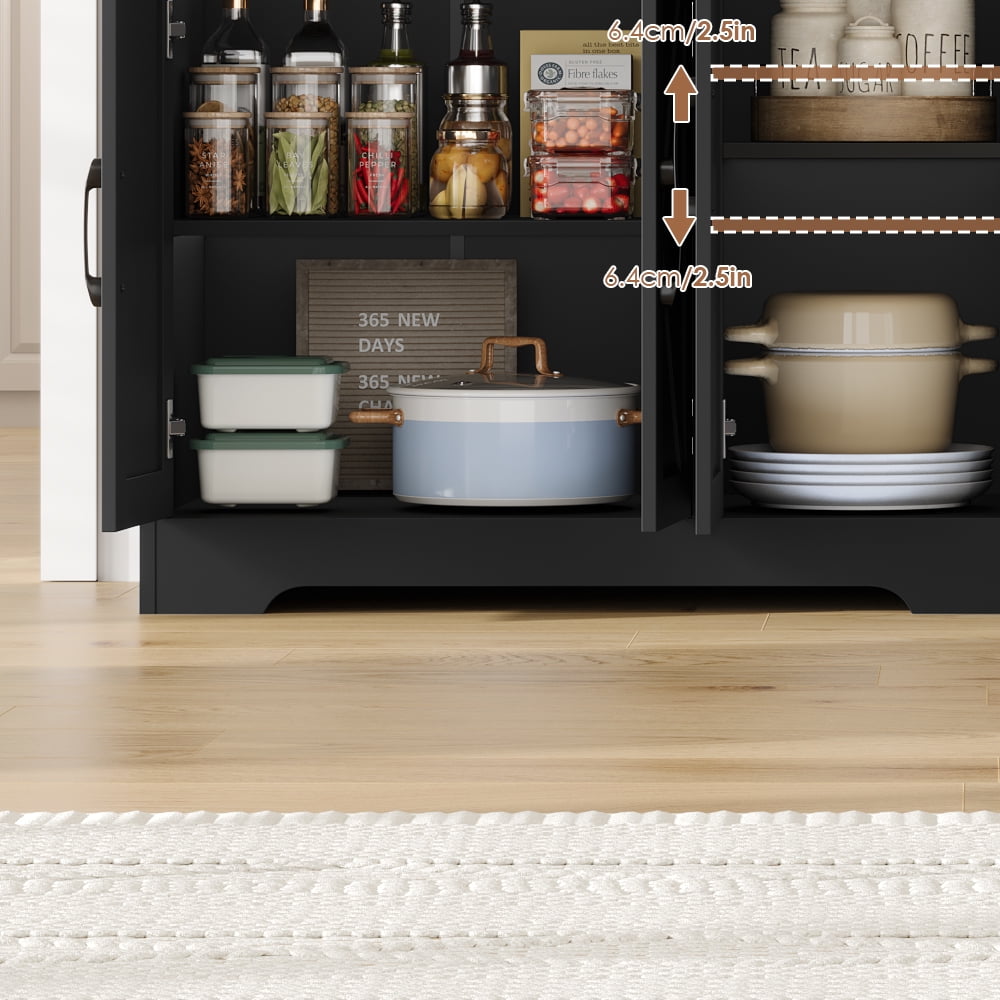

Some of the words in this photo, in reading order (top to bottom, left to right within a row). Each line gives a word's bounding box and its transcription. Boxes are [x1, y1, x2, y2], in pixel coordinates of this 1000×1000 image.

[896, 33, 971, 74] OFFEE
[567, 67, 591, 79] Fibre
[592, 67, 618, 79] flakes
[777, 47, 821, 90] TEA
[201, 151, 226, 159] STAR
[361, 151, 393, 159] CHILLI
[359, 161, 397, 169] PEPPER
[358, 312, 390, 328] 365
[398, 312, 441, 328] NEW
[358, 337, 405, 353] DAYS
[358, 374, 390, 390] 365
